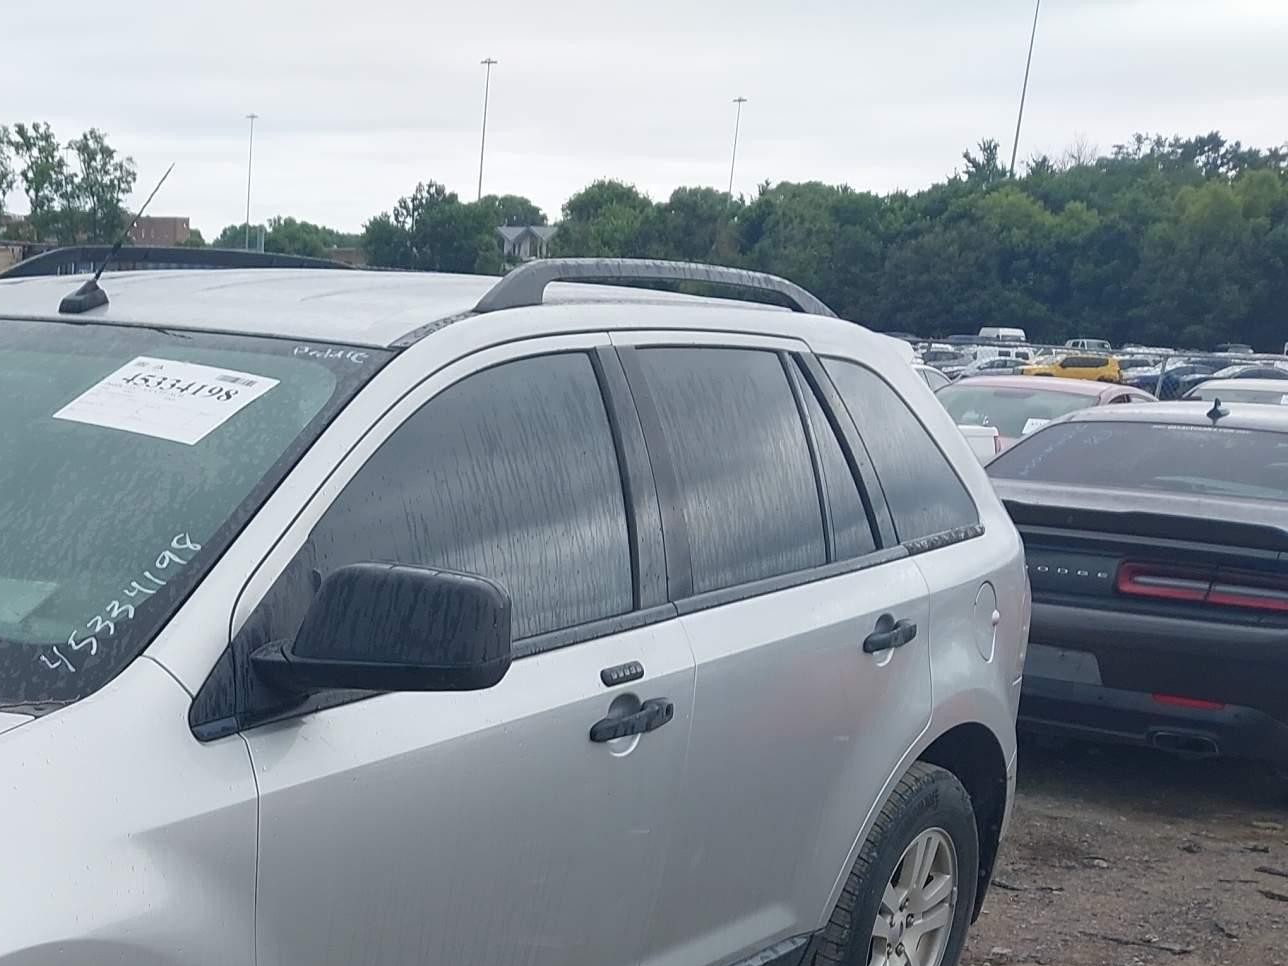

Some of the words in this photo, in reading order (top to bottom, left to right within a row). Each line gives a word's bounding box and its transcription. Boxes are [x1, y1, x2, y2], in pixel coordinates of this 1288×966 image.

[122, 372, 240, 402] 45334198
[1025, 564, 1108, 579] ODGE
[39, 531, 203, 673] 45334198
